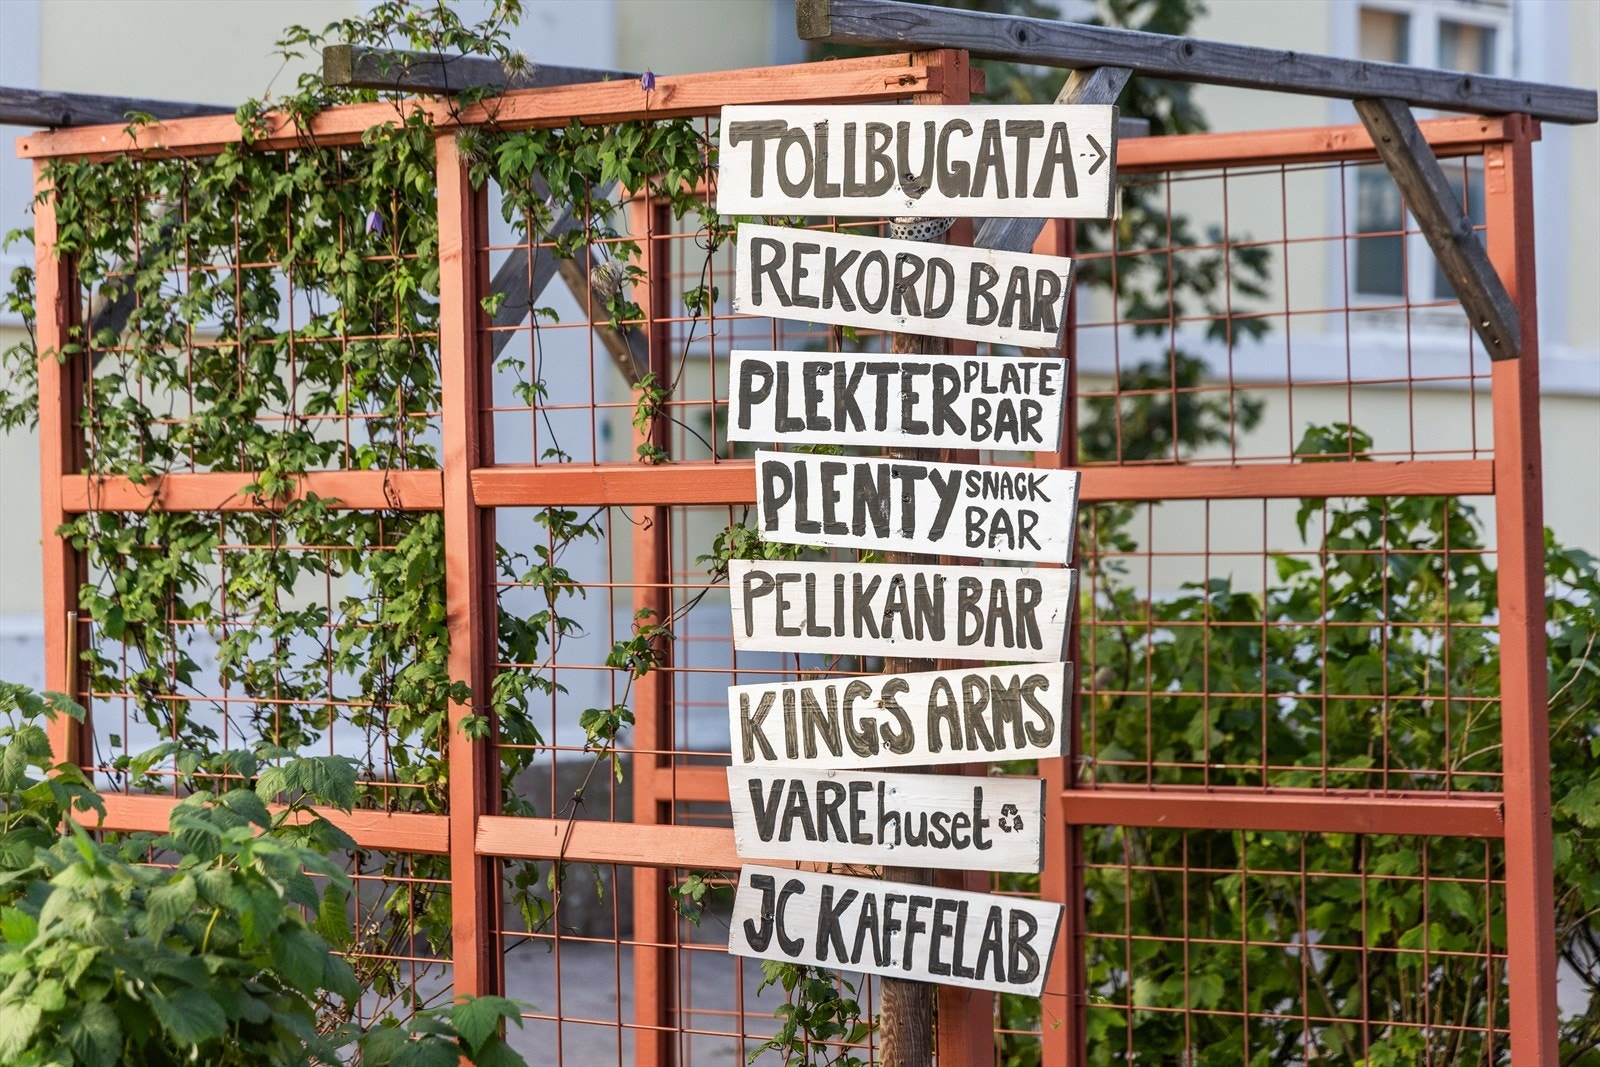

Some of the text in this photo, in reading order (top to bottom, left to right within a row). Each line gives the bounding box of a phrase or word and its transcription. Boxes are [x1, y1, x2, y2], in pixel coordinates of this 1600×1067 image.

[728, 118, 1079, 199] TOLLBUGATA
[750, 237, 1062, 333] REKORD BAR
[737, 359, 967, 436] PLEKTER
[963, 360, 1062, 396] PLATE
[970, 397, 1044, 445] BAR
[761, 460, 963, 542] PLENTY
[964, 469, 1052, 503] SNACK
[964, 505, 1042, 551] BAR
[742, 570, 1043, 650] PELIKAN BAR
[739, 673, 1055, 764] KINGS ARMS
[747, 778, 993, 851] VAREhuset
[742, 873, 1041, 985] JC KAFFELAB
